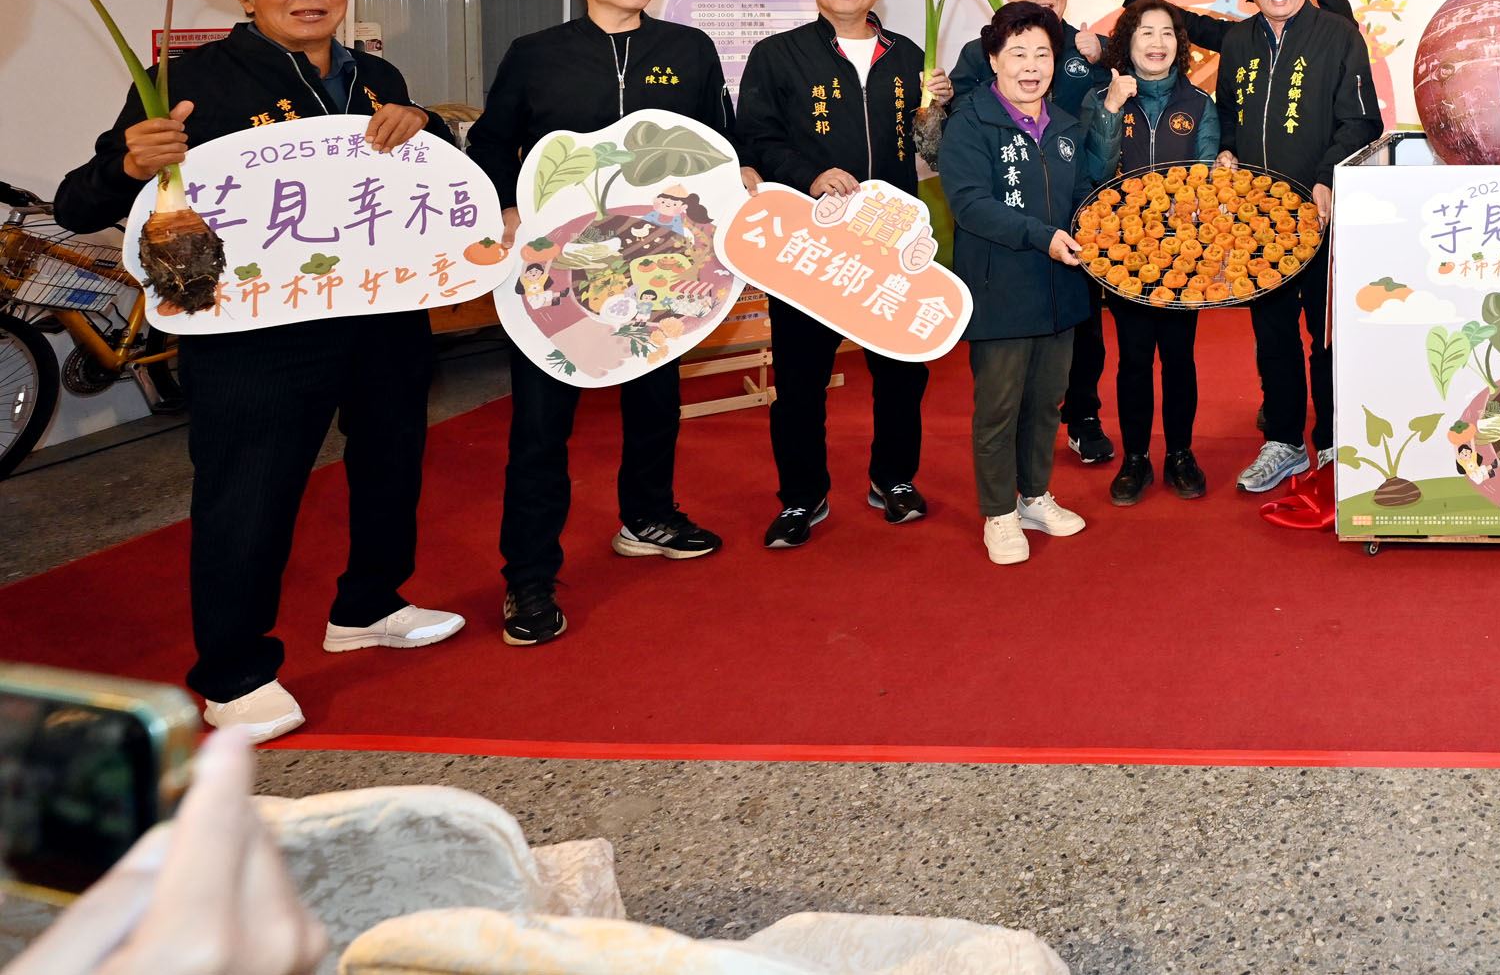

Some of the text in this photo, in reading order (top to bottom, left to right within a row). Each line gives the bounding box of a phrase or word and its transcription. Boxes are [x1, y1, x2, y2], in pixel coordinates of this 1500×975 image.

[240, 132, 430, 169] 2025 苗栗館
[846, 190, 921, 256] 讚
[741, 208, 955, 341] 公館鄉農會
